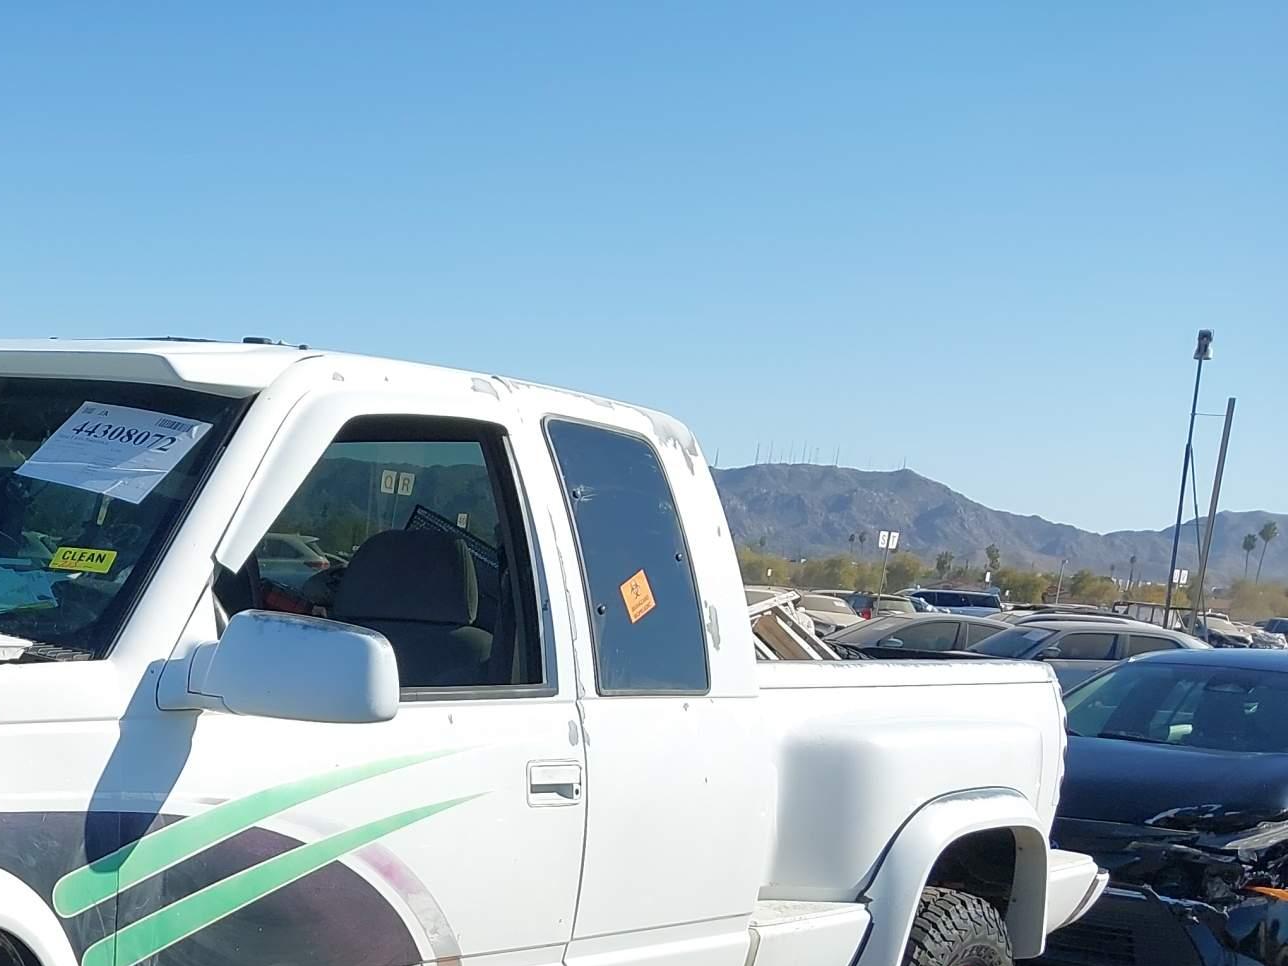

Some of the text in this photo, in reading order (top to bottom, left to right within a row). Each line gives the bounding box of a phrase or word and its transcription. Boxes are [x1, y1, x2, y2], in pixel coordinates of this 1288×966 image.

[72, 420, 177, 452] 44308072
[401, 477, 410, 491] R
[61, 550, 107, 564] CLEAN
